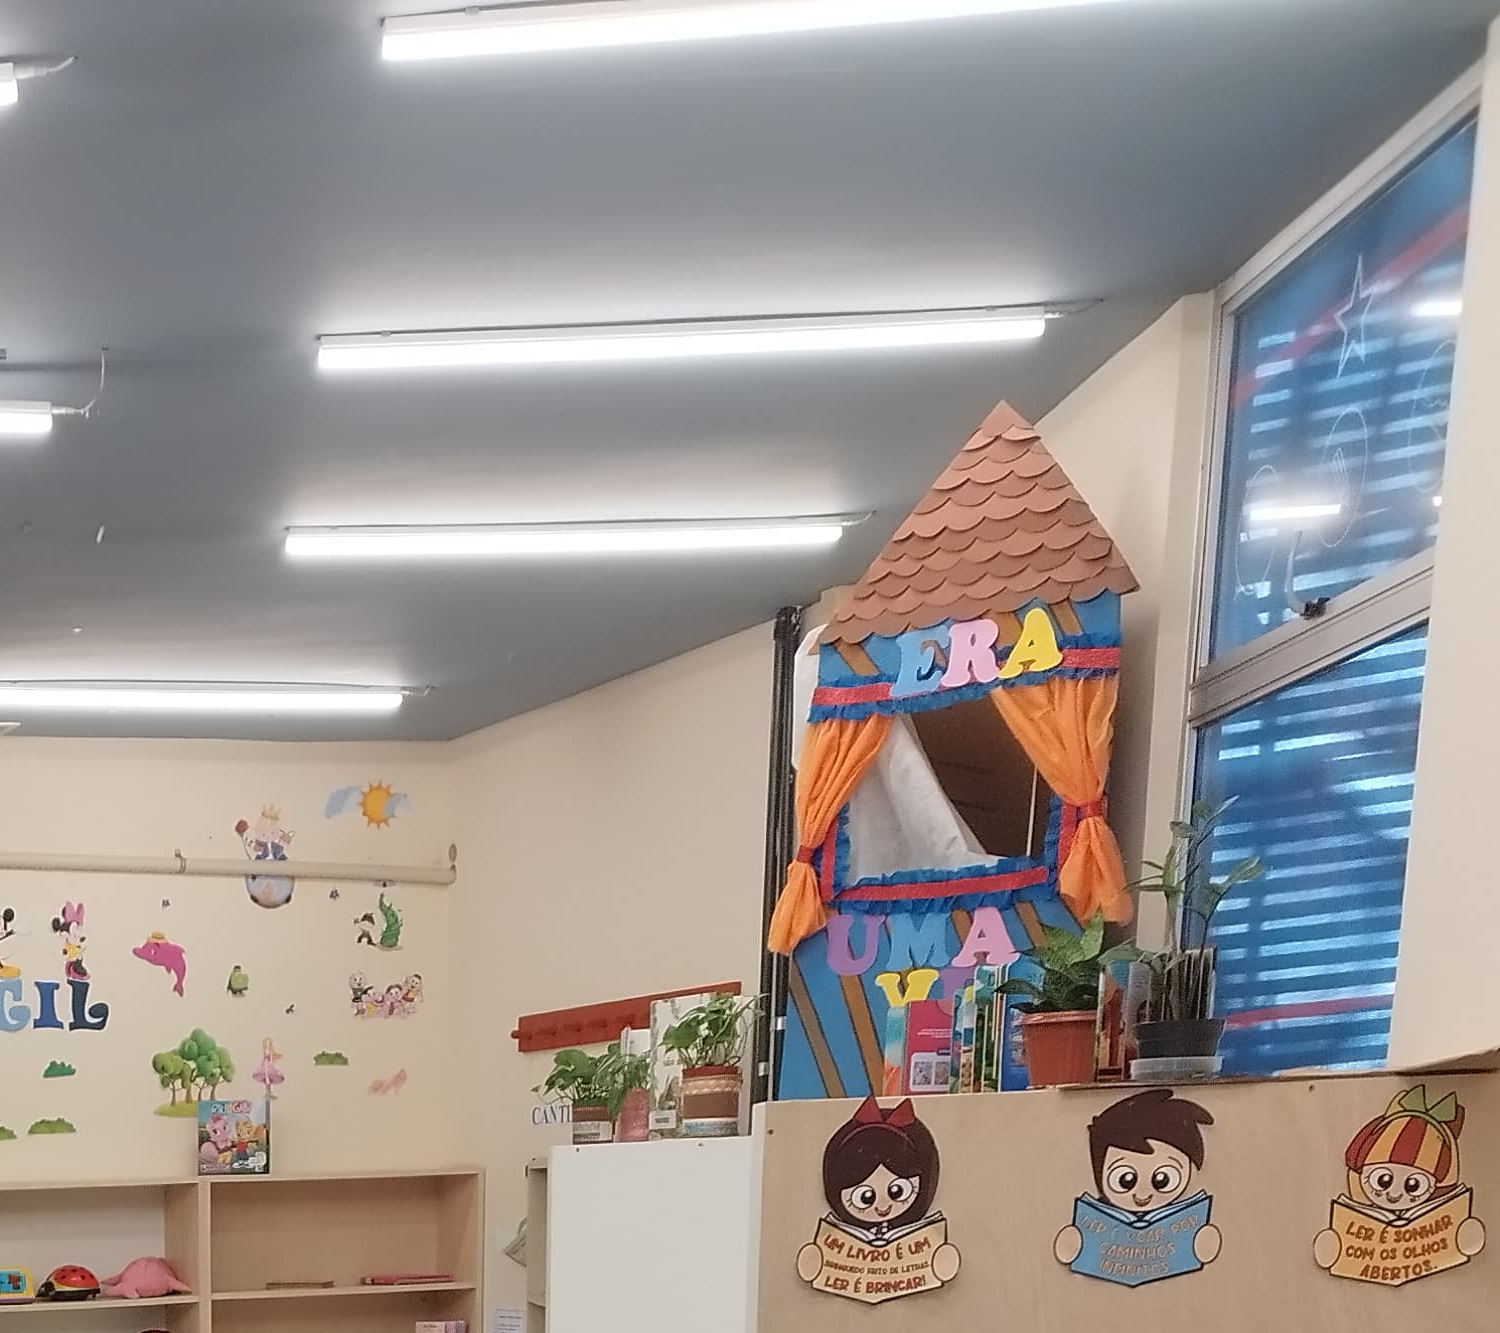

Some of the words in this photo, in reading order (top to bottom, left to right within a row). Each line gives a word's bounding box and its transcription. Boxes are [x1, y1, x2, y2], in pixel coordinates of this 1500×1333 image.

[890, 608, 1063, 698] ERA
[827, 907, 1020, 976] UMA
[1346, 1221, 1375, 1241] LER
[1380, 1226, 1389, 1244] É
[1394, 1215, 1453, 1242] SONHAR
[824, 1234, 845, 1254] UM
[846, 1246, 890, 1262] LIVRO
[895, 1243, 903, 1260] É
[908, 1237, 931, 1255] UM
[1100, 1241, 1176, 1259] CAMINHOS
[1346, 1245, 1375, 1260] COM
[1380, 1247, 1397, 1260] OS
[1403, 1238, 1448, 1259] OLHOS
[1360, 1260, 1438, 1280] ABERTOS.
[824, 1276, 849, 1290] LER
[854, 1277, 862, 1293] É
[866, 1274, 926, 1294] BRINCAR!
